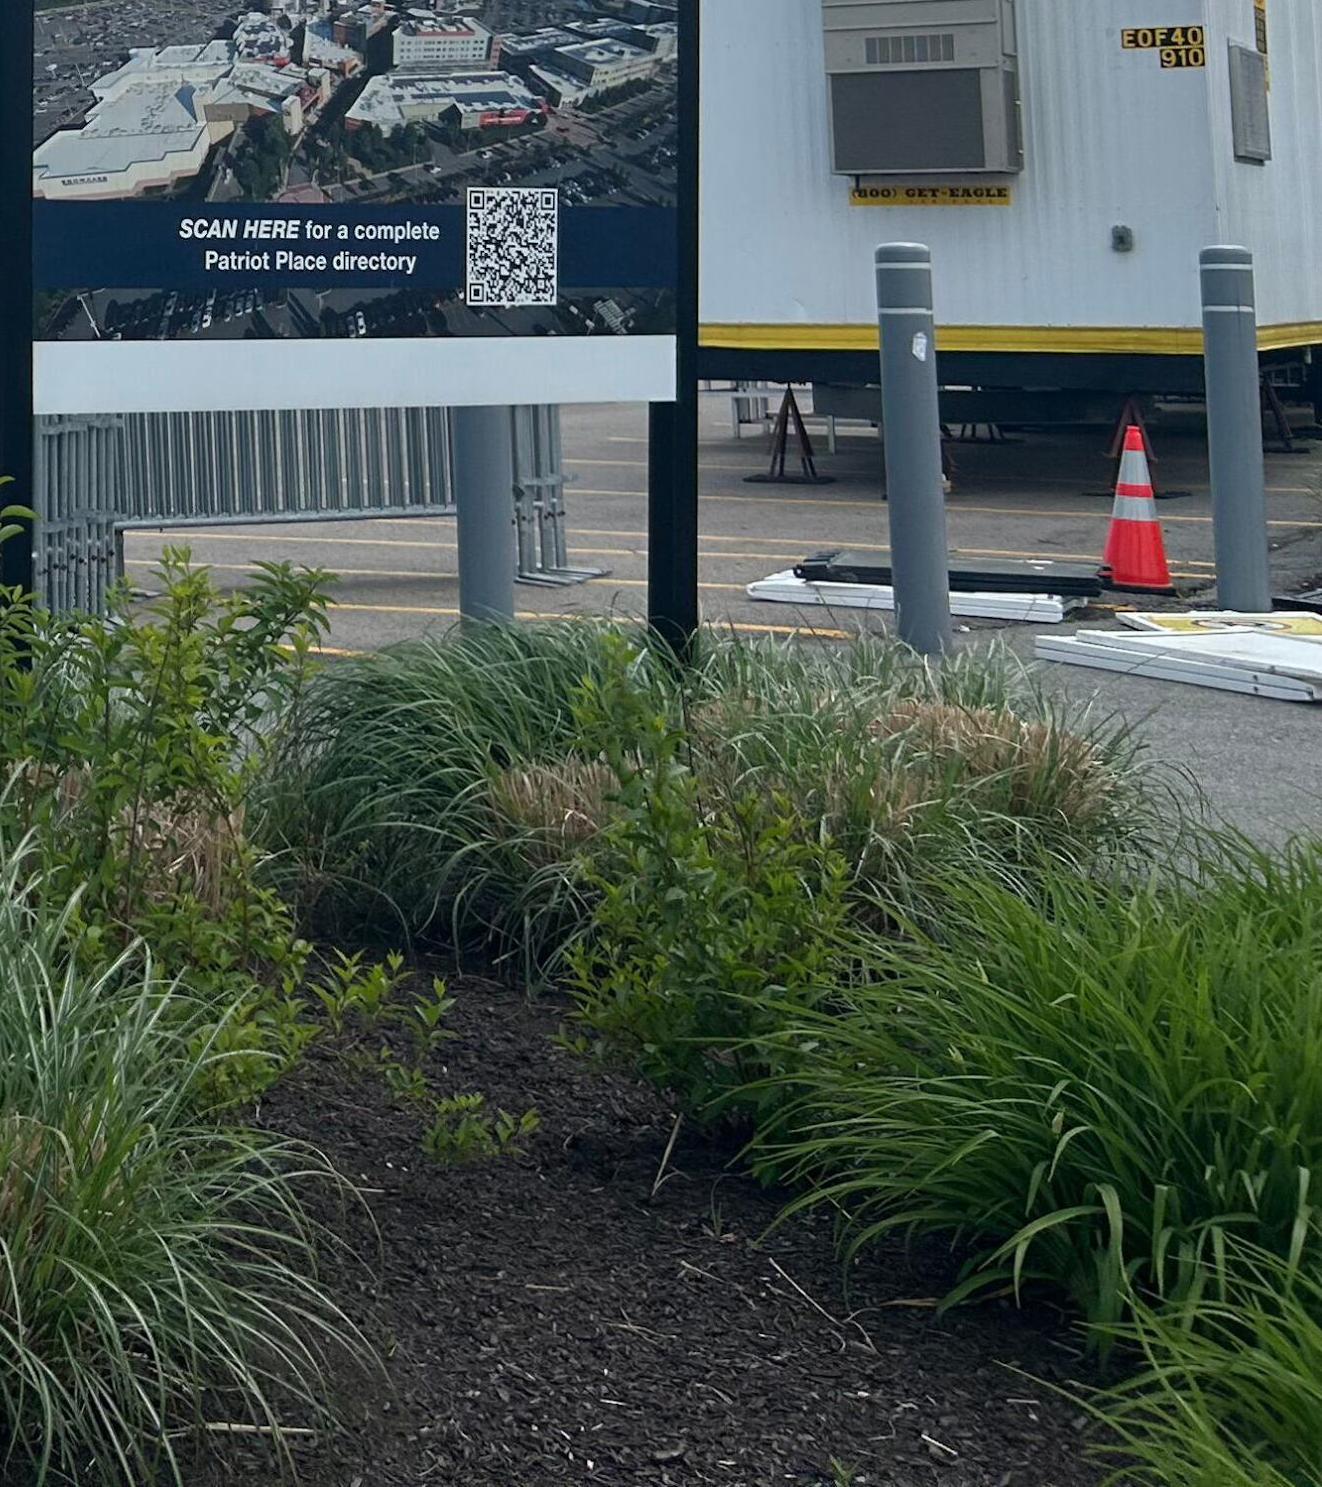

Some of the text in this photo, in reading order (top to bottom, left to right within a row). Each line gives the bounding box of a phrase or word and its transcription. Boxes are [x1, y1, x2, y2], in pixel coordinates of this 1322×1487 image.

[1161, 49, 1204, 67] 910
[905, 187, 1007, 198] GET-EAGLE
[179, 219, 440, 244] SCAN HERE for a complete
[205, 250, 417, 274] Patriot Place directory
